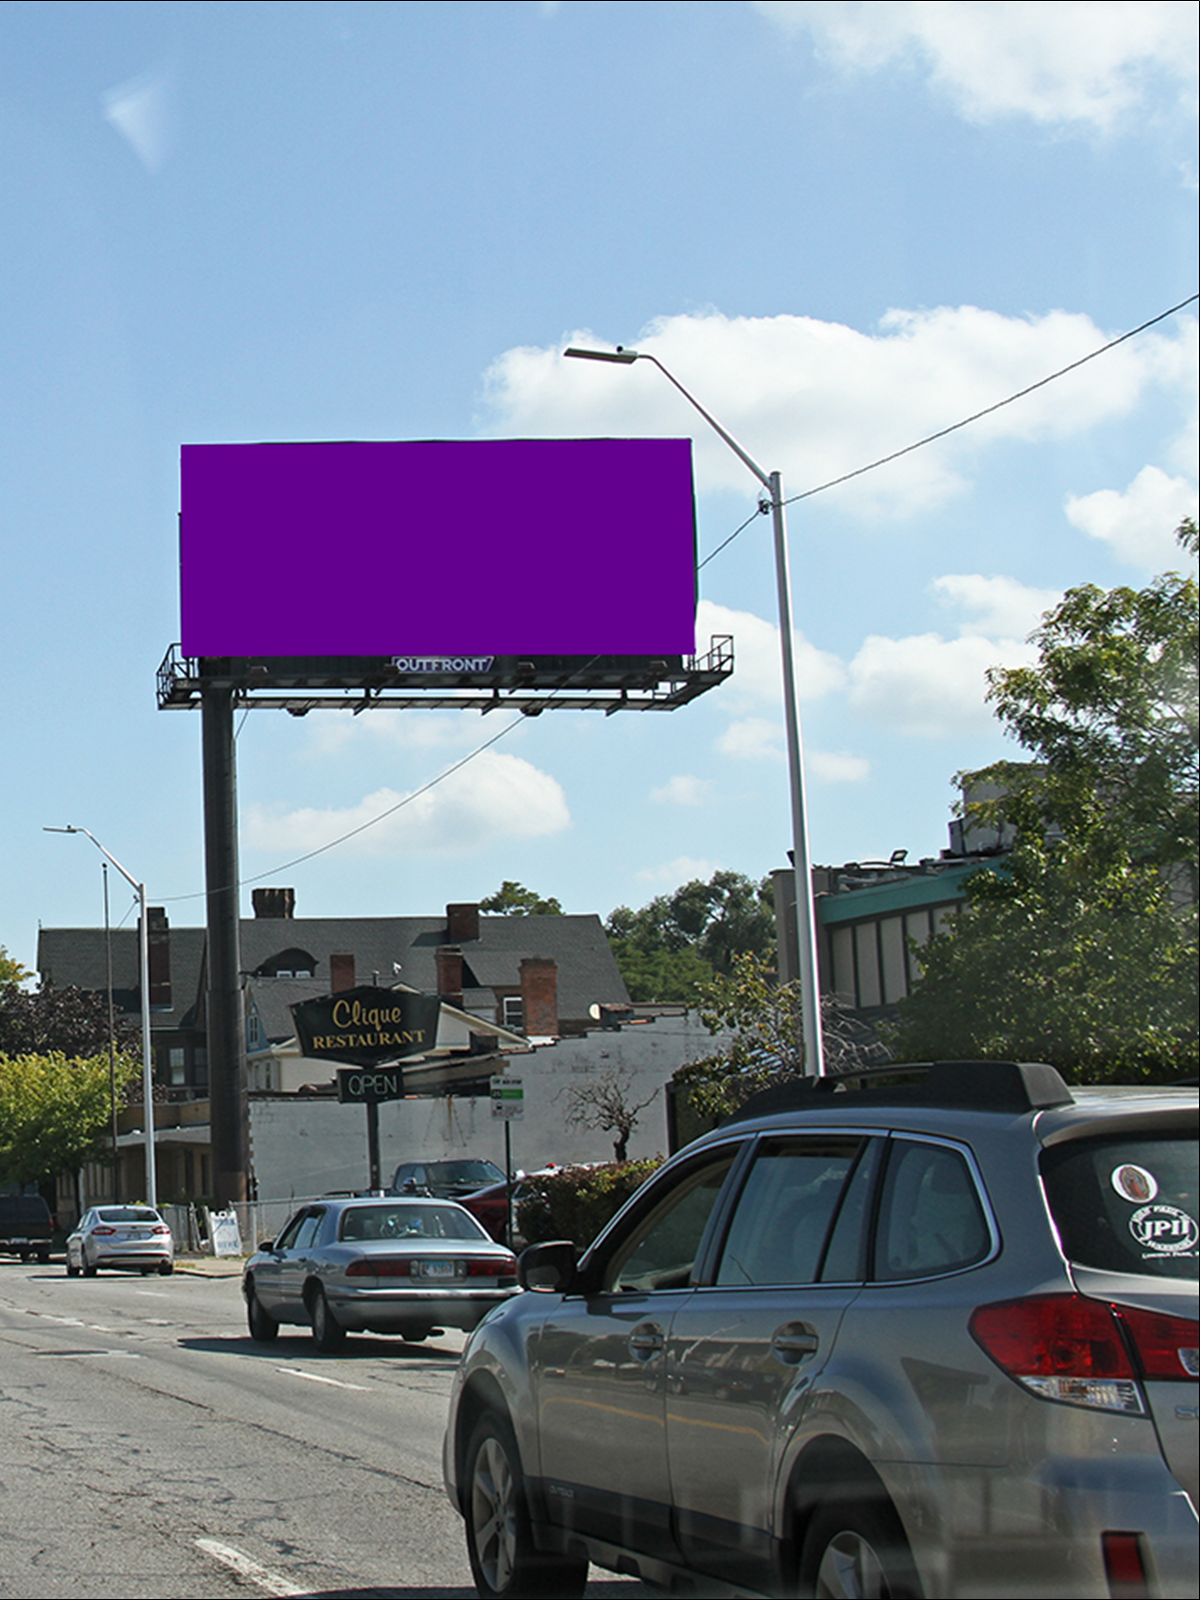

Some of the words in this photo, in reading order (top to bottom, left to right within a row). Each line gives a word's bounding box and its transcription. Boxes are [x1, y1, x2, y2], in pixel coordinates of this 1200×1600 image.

[396, 658, 487, 671] OUTFRONT
[332, 1000, 402, 1032] Clique
[313, 1029, 426, 1049] RESTAURANT
[348, 1074, 397, 1095] OPEN
